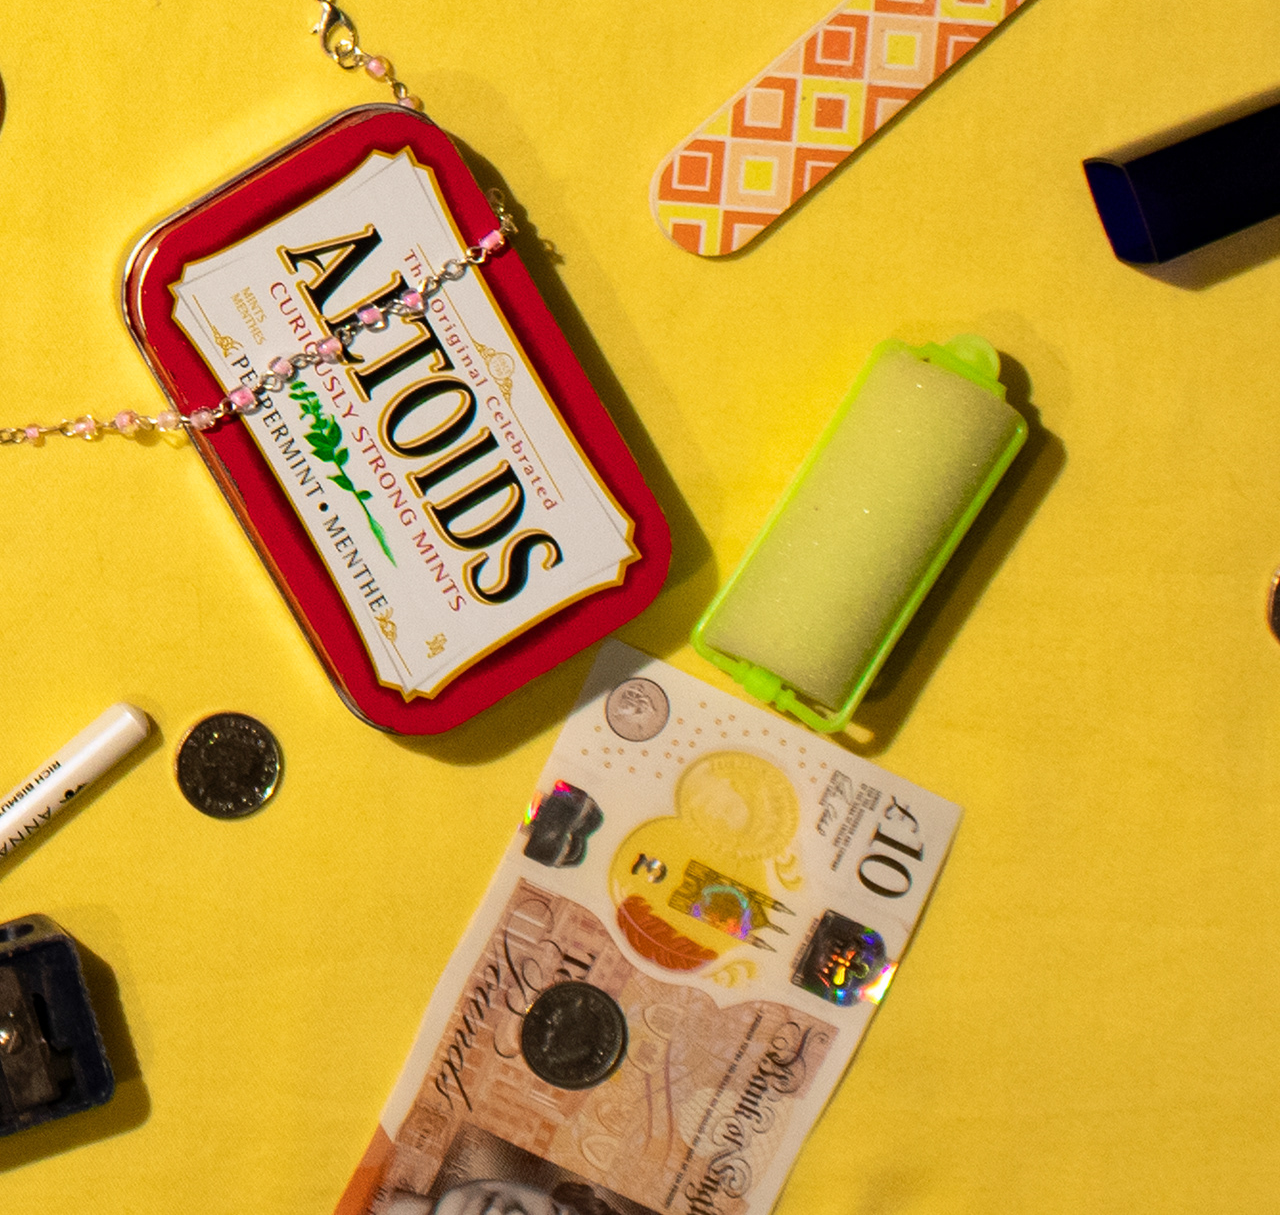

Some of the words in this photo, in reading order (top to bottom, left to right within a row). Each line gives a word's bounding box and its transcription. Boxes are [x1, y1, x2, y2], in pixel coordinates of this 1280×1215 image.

[231, 292, 266, 346] MENTHES
[241, 286, 267, 324] MINTS
[276, 223, 564, 606] ALTOIDS
[430, 298, 489, 388] Original
[486, 395, 559, 511] Celebrated
[231, 354, 326, 499] PEPERMINT
[323, 514, 389, 613] MENTHE
[351, 425, 417, 528] STRONG
[412, 528, 467, 614] MINTS
[34, 760, 62, 785] RICH
[856, 795, 923, 899] £10
[685, 1148, 752, 1215] Engl
